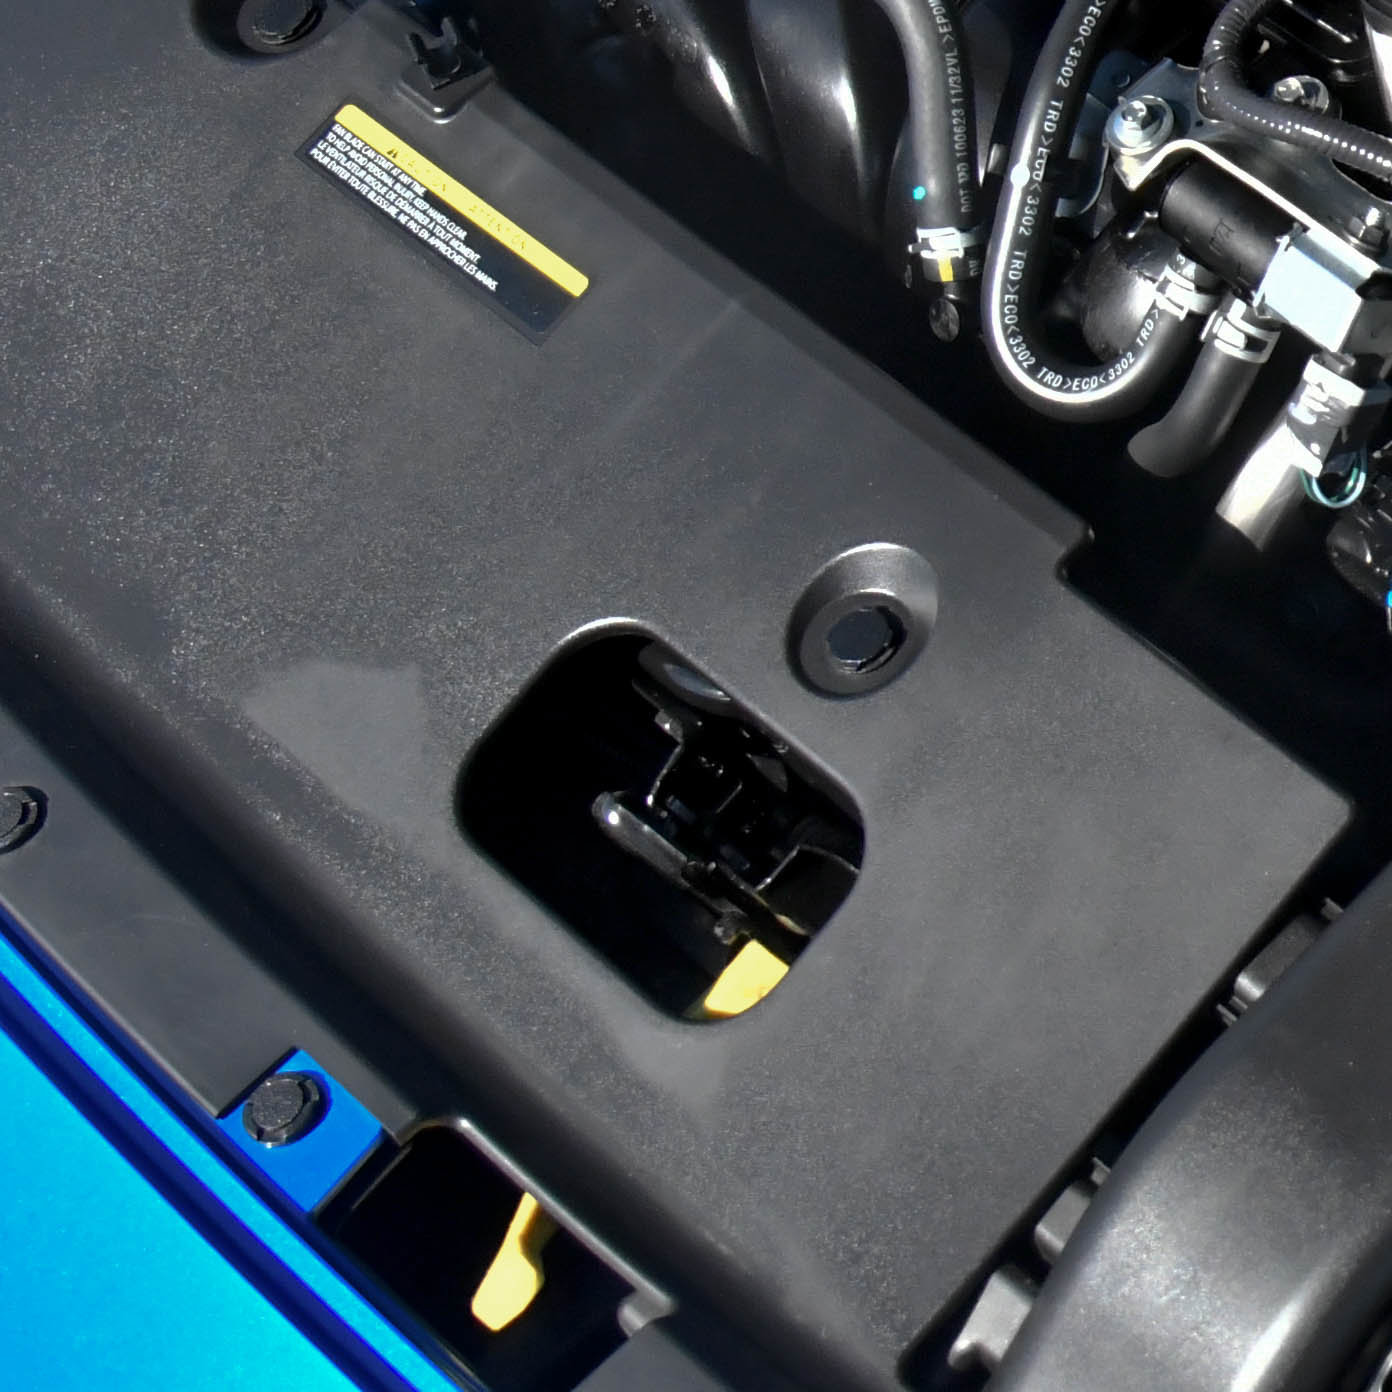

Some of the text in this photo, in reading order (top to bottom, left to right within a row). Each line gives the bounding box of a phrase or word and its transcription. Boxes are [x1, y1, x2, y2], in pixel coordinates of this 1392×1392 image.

[325, 131, 337, 143] TO
[333, 137, 351, 153] HELP
[347, 148, 368, 166] AVOID
[364, 161, 396, 187] PERSONAL
[412, 196, 430, 212] KEEP
[426, 207, 449, 226] HANDS
[332, 123, 347, 136] FAN
[343, 131, 364, 149] BLADE
[361, 144, 377, 159] CAN
[373, 154, 394, 171] START
[390, 166, 401, 177] AT
[397, 172, 413, 186] ANY
[952, 108, 969, 157] 100623
[309, 147, 330, 165] POUR
[347, 175, 370, 195] TOUTE
[397, 212, 409, 224] NE
[406, 219, 421, 233] PAS
[417, 228, 430, 240] EN
[426, 234, 466, 267] APPROCHER
[463, 261, 477, 275] LES
[317, 139, 328, 150] LE
[324, 144, 367, 178] VENTILATEUR
[363, 173, 389, 195] RISQUE
[385, 190, 397, 201] DE
[432, 225, 452, 242] TOUT
